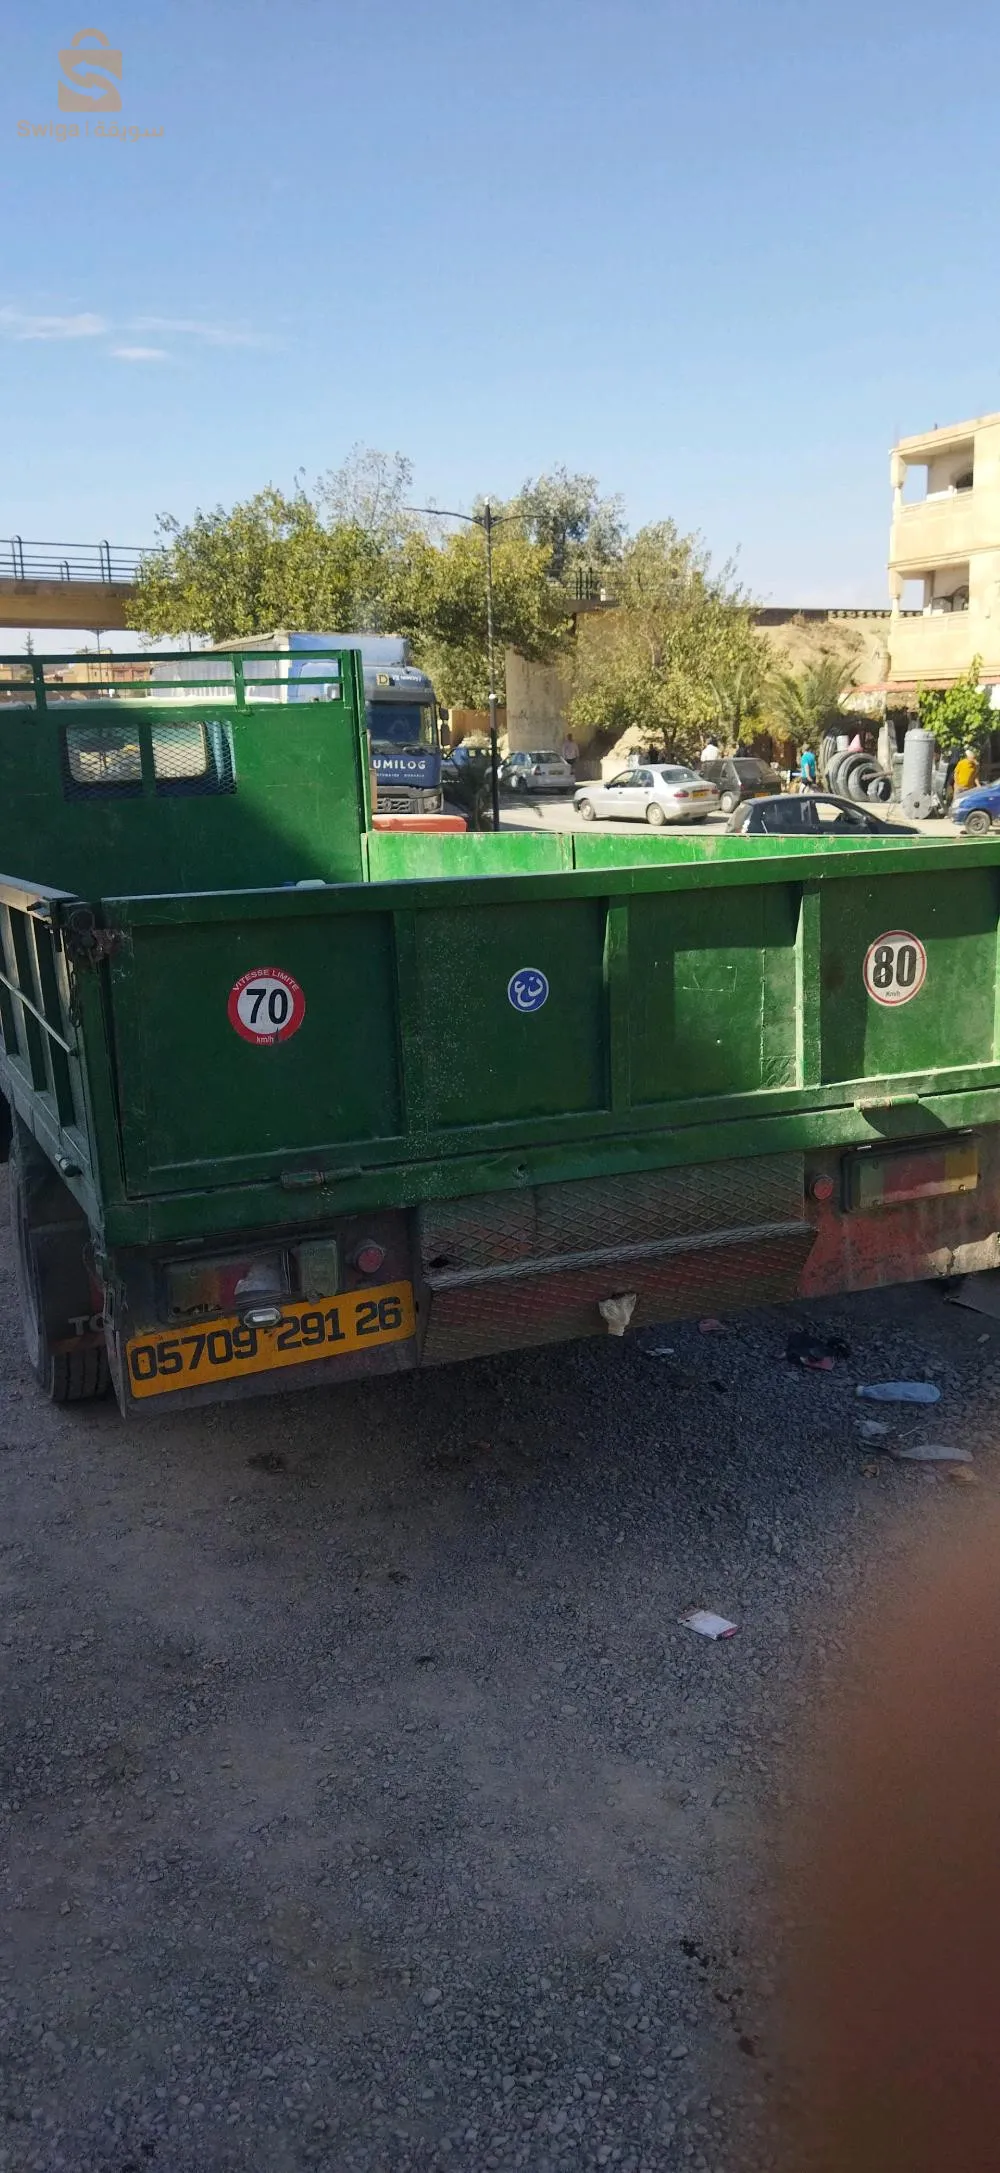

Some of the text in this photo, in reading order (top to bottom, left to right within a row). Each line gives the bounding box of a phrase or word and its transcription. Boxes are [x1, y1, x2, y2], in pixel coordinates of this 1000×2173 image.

[233, 969, 300, 992] VITESSE LIMITE
[873, 945, 917, 988] 80
[246, 988, 289, 1025] 70
[256, 1035, 275, 1044] km/h
[131, 1296, 403, 1381] 05709 291 26
